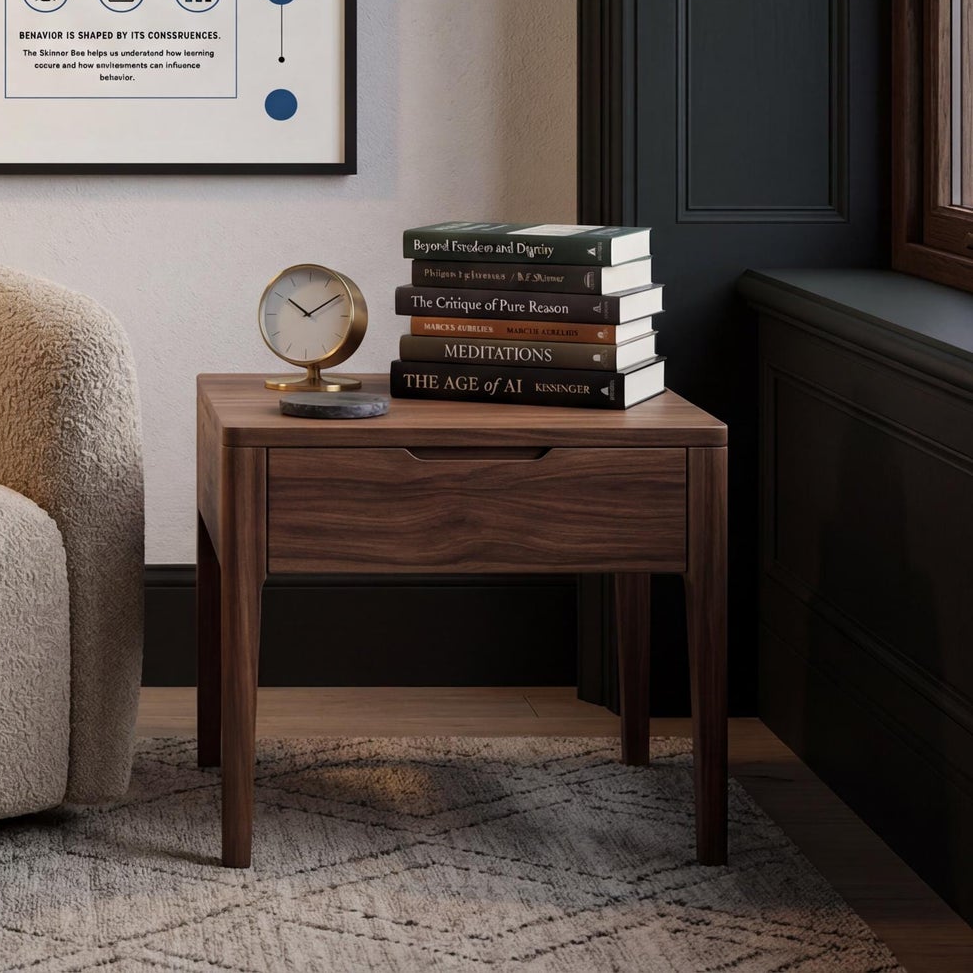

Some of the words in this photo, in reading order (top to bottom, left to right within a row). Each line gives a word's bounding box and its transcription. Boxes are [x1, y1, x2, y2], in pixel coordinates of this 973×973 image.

[67, 31, 74, 39] IS
[78, 31, 113, 39] SHAPED
[131, 31, 145, 39] ITS
[87, 50, 107, 58] helps
[411, 295, 433, 308] The
[436, 296, 482, 314] Critique
[484, 298, 499, 311] of
[499, 299, 526, 312] Pure
[528, 300, 569, 314] Reason
[444, 344, 553, 362] MEDITATIONS
[403, 374, 439, 389] THE
[443, 376, 480, 391] AGE
[484, 377, 502, 395] of
[504, 379, 523, 393] AI
